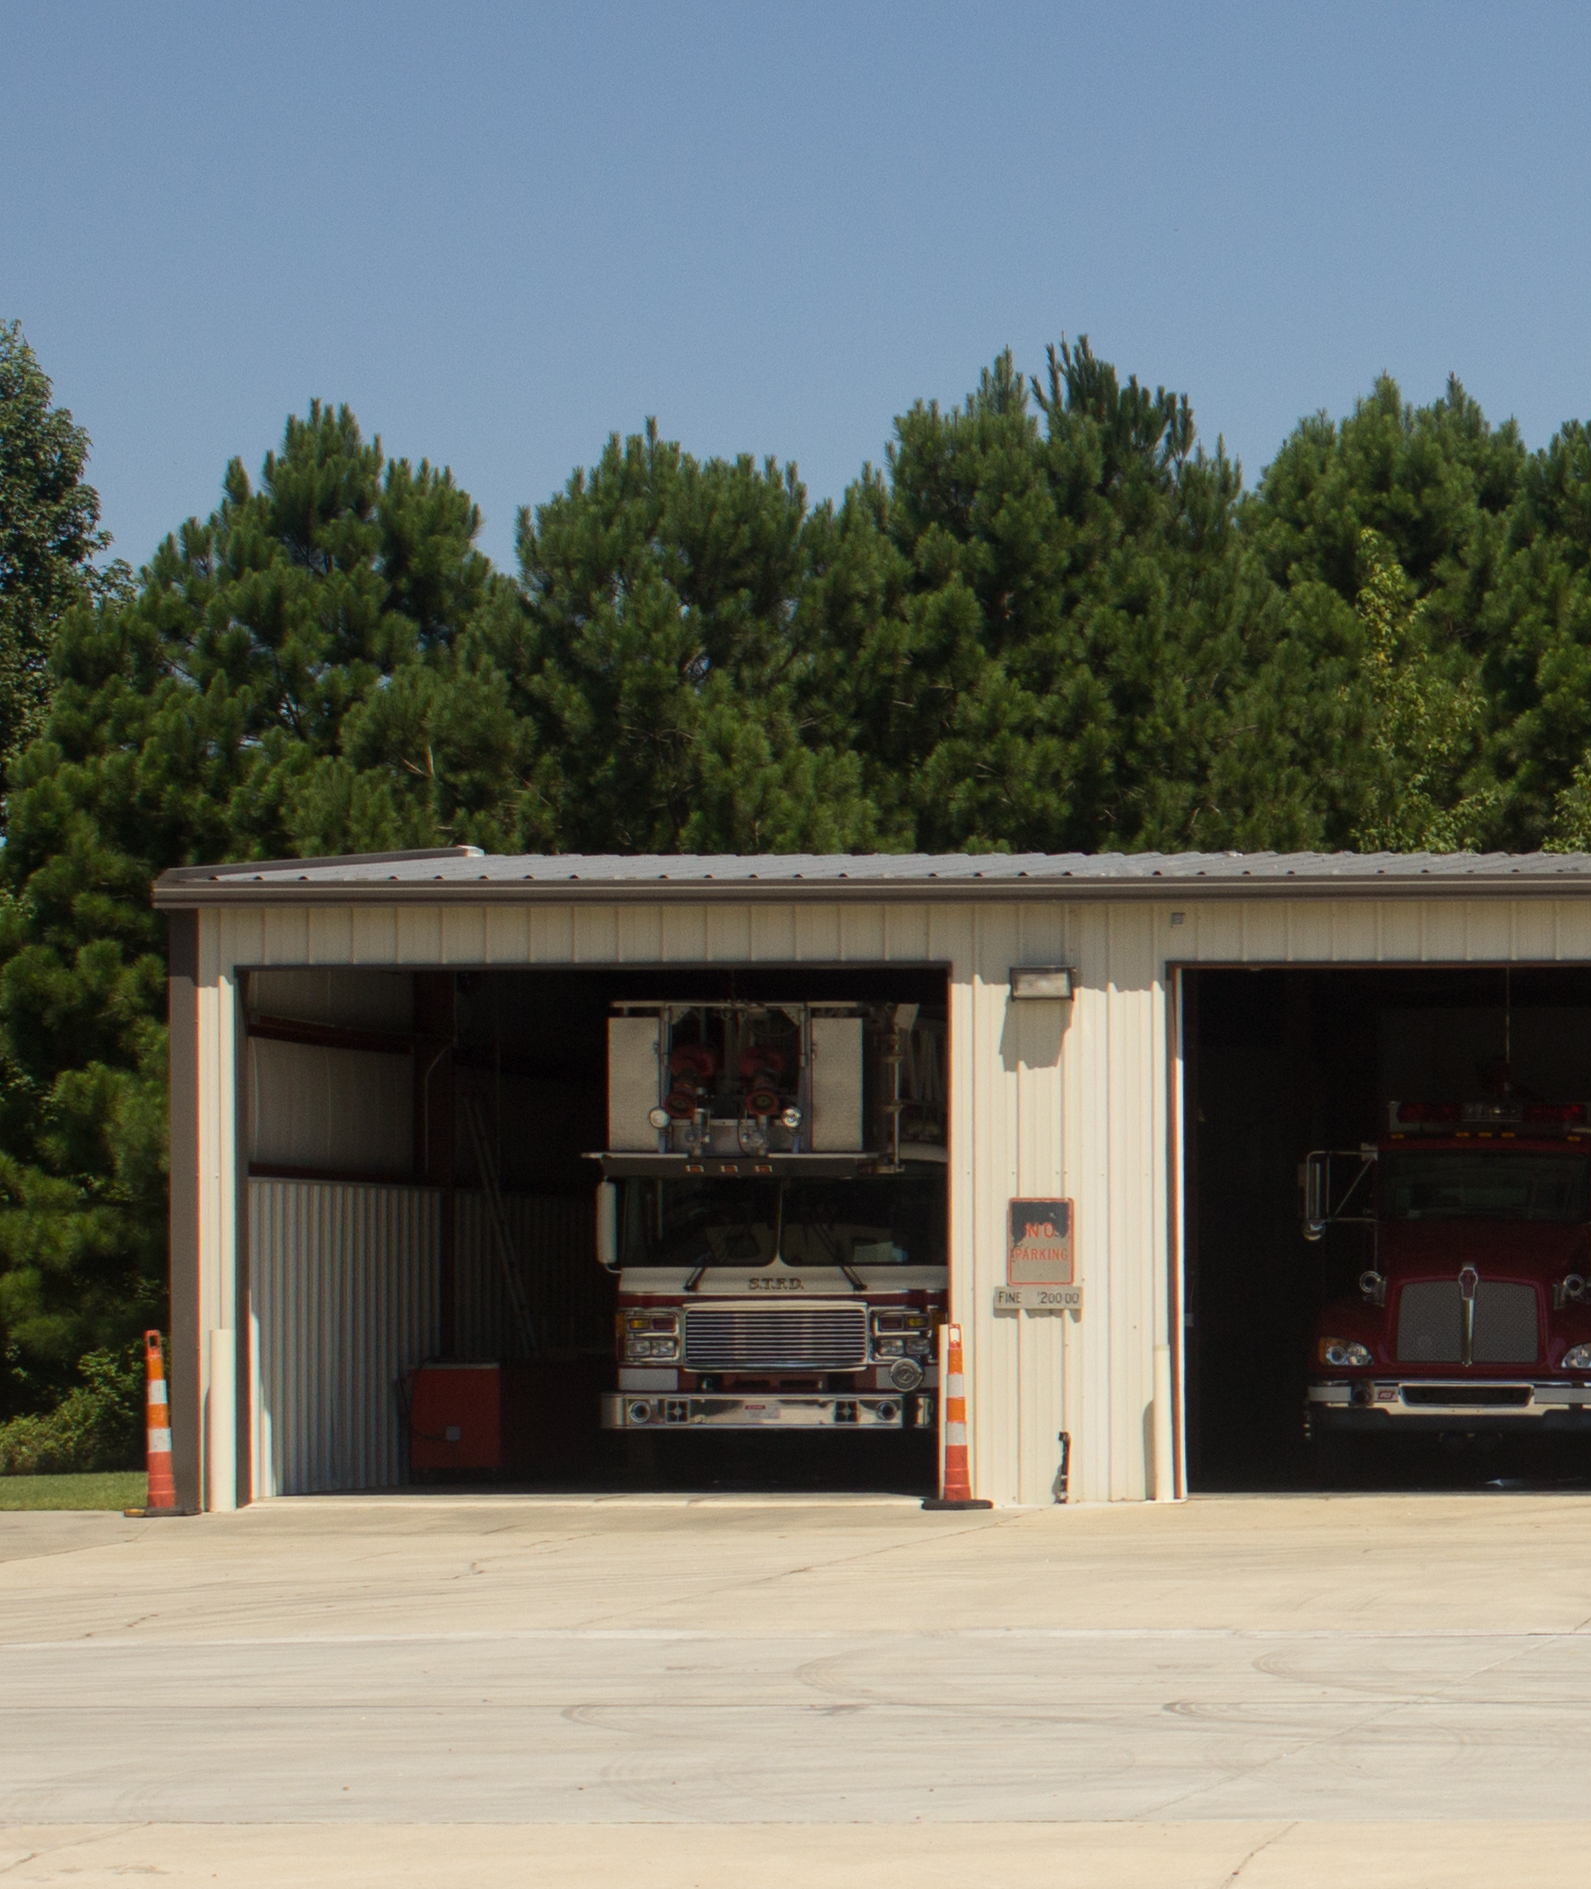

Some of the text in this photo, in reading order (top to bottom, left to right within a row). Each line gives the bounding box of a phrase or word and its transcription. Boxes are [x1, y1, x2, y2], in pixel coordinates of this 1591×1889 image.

[1024, 1222, 1056, 1239] NO
[1013, 1248, 1068, 1261] PARKING
[998, 1291, 1022, 1304] FINE
